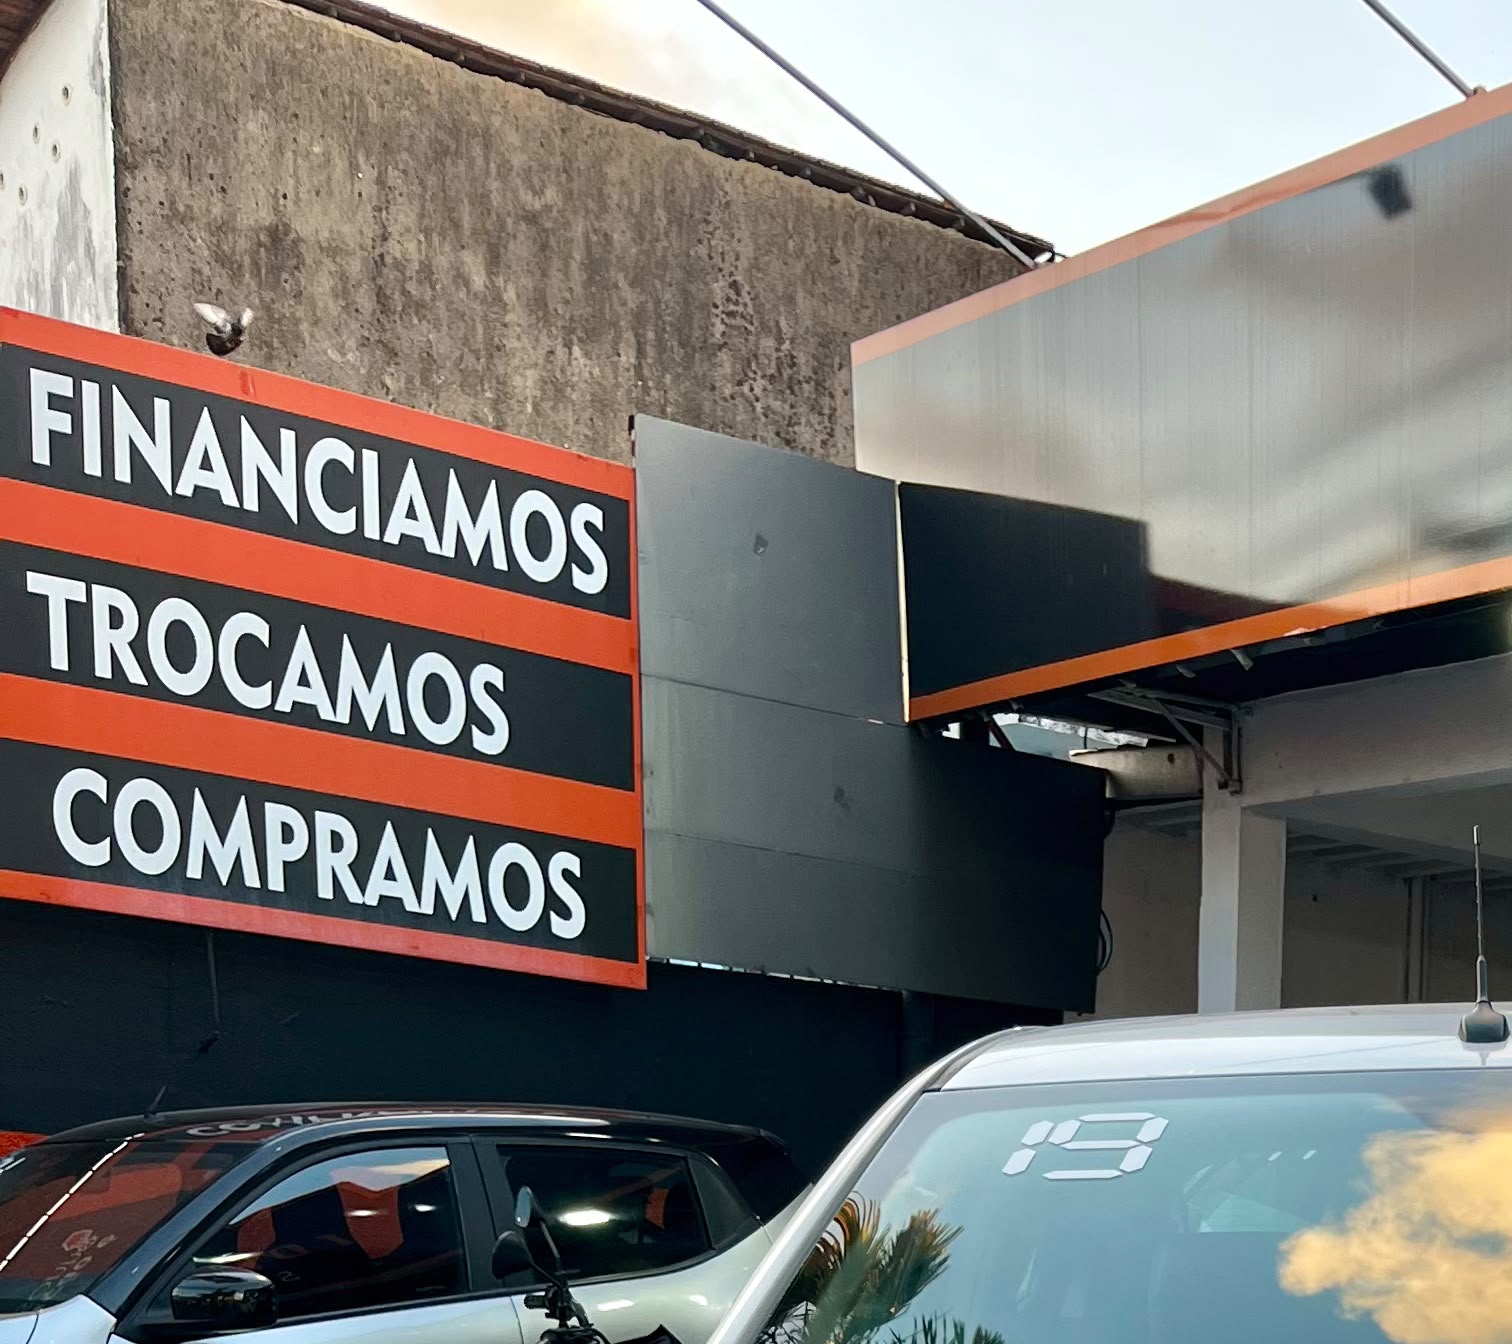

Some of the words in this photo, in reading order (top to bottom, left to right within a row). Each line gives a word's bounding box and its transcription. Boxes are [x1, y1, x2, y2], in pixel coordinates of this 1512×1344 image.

[28, 367, 609, 595] FINANCIAMOS
[26, 570, 510, 756] TROCAMOS
[52, 767, 587, 940] COMPRAMOS
[1001, 1112, 1169, 1180] 19
